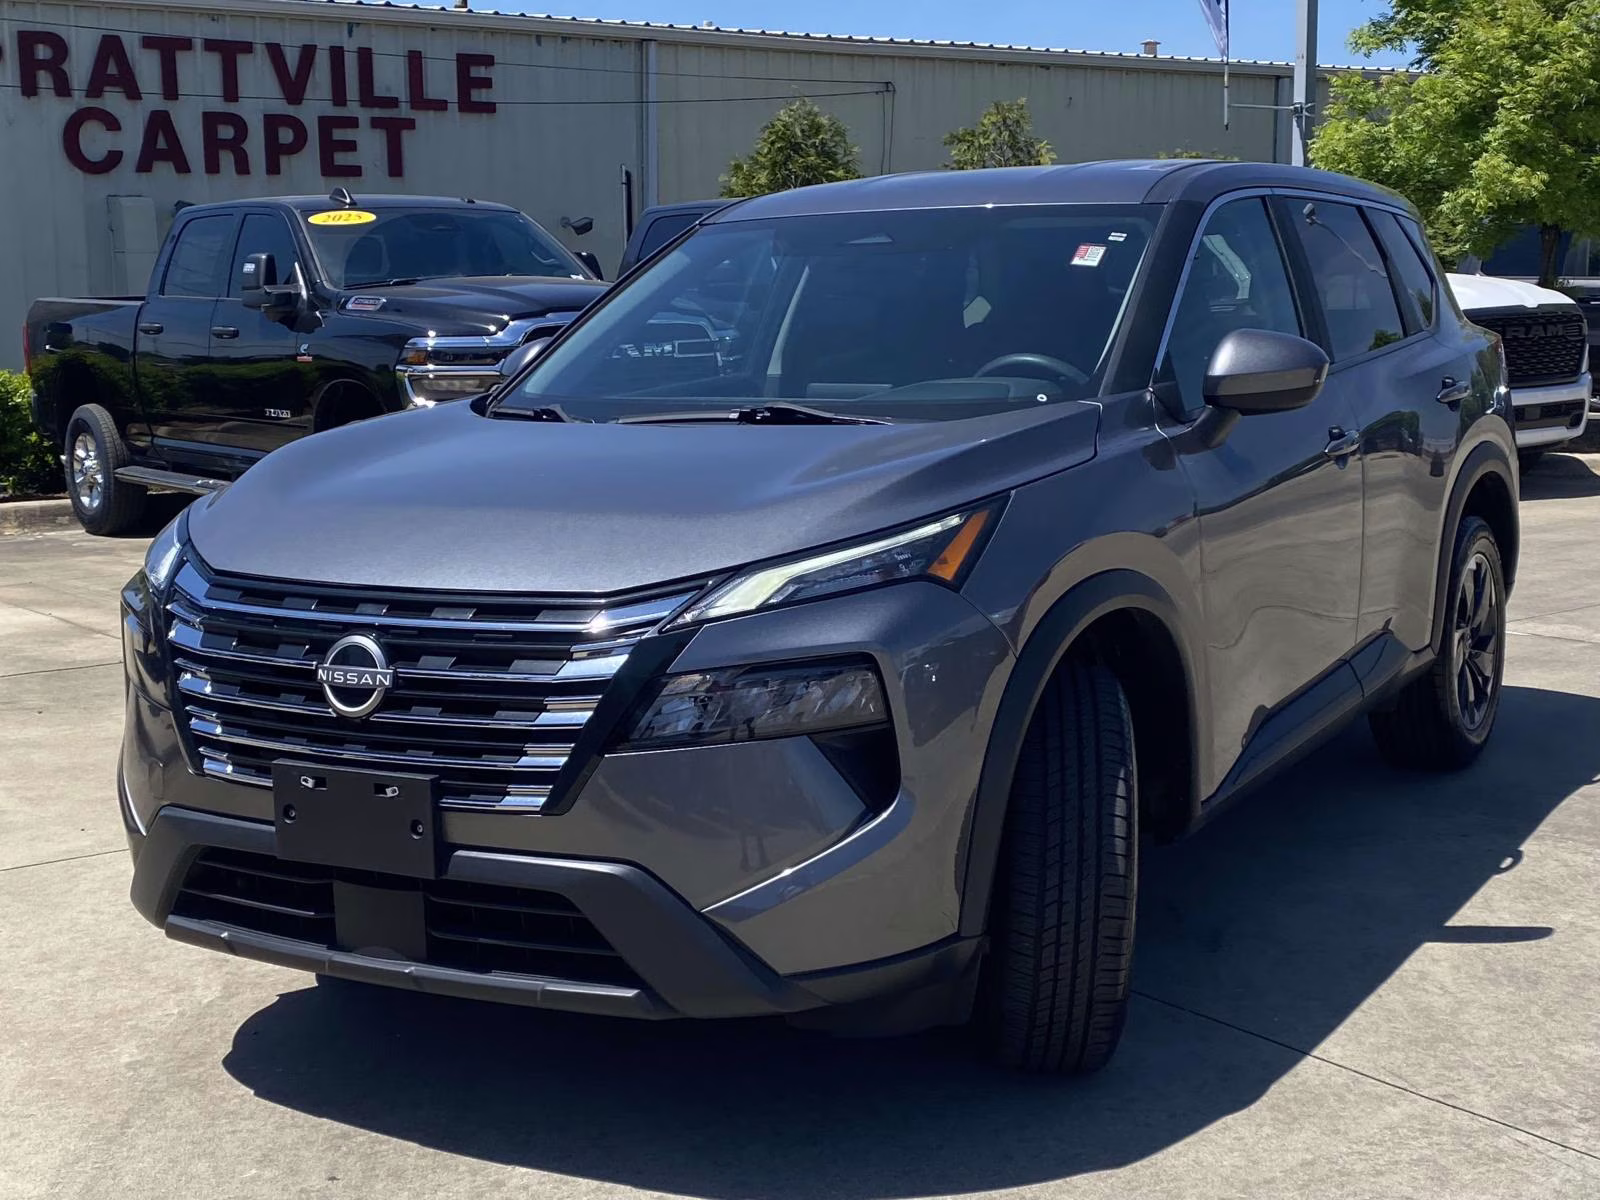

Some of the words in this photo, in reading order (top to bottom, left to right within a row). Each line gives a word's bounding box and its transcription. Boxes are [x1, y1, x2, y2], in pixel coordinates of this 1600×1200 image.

[0, 30, 496, 114] RATTVILLE
[63, 106, 416, 178] CARPET
[1504, 324, 1563, 338] RAM
[317, 668, 390, 686] NISSAN
